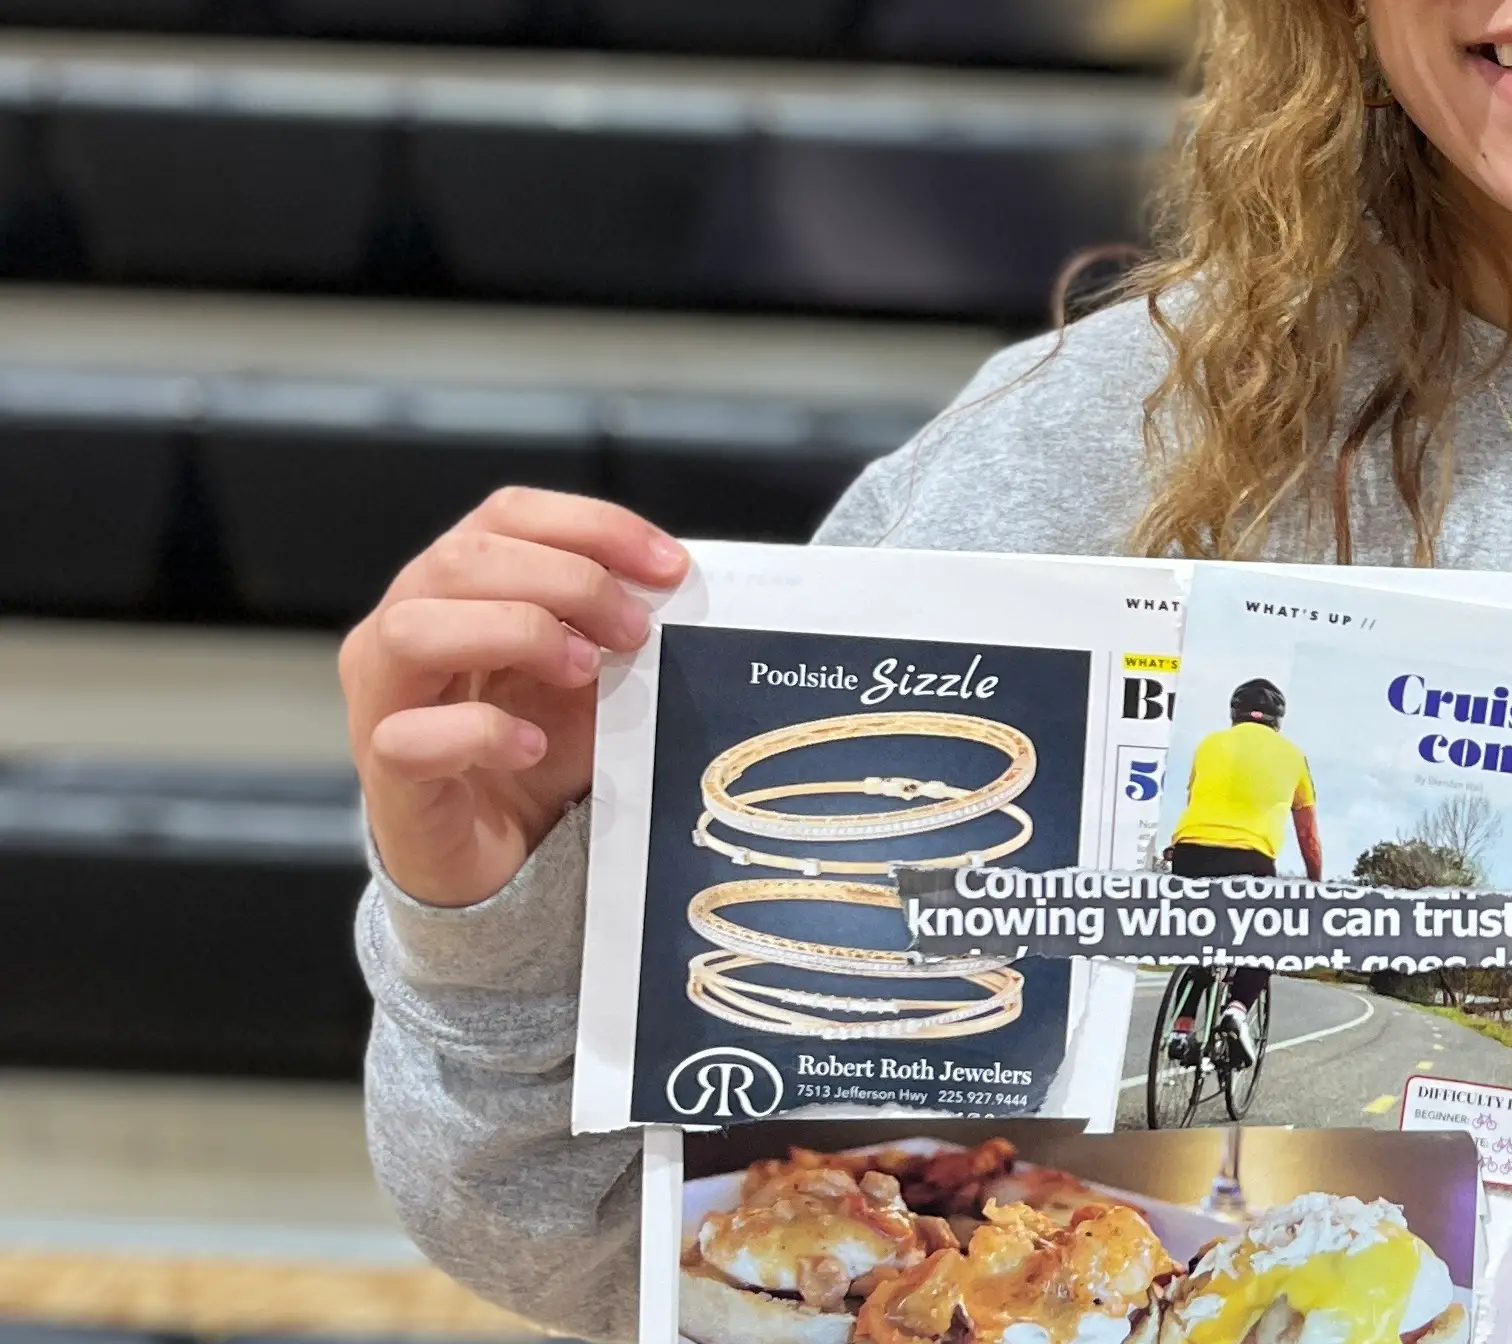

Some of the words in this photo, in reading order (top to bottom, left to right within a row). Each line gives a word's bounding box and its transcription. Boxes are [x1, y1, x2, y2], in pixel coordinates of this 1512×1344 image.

[1246, 600, 1319, 621] WHAT'S
[1328, 612, 1352, 626] UP
[1125, 657, 1178, 671] WHAT'S
[750, 662, 858, 690] Poolside
[860, 654, 999, 705] Sizzle
[1125, 760, 1165, 802] 5
[908, 898, 1105, 945] knowing
[1117, 898, 1217, 937] who
[1227, 906, 1310, 946] you
[1322, 907, 1401, 937] can
[798, 1055, 875, 1079] Robert
[879, 1058, 934, 1081] Roth
[938, 1061, 1033, 1085] Jewelers
[796, 1084, 831, 1099] 7513
[834, 1086, 896, 1101] Jefferson
[899, 1089, 929, 1104] Hwy
[938, 1090, 1028, 1107] 225.927.9444
[1418, 1085, 1504, 1109] DIFFICULTY
[1415, 1108, 1470, 1125] BEGINNER:
